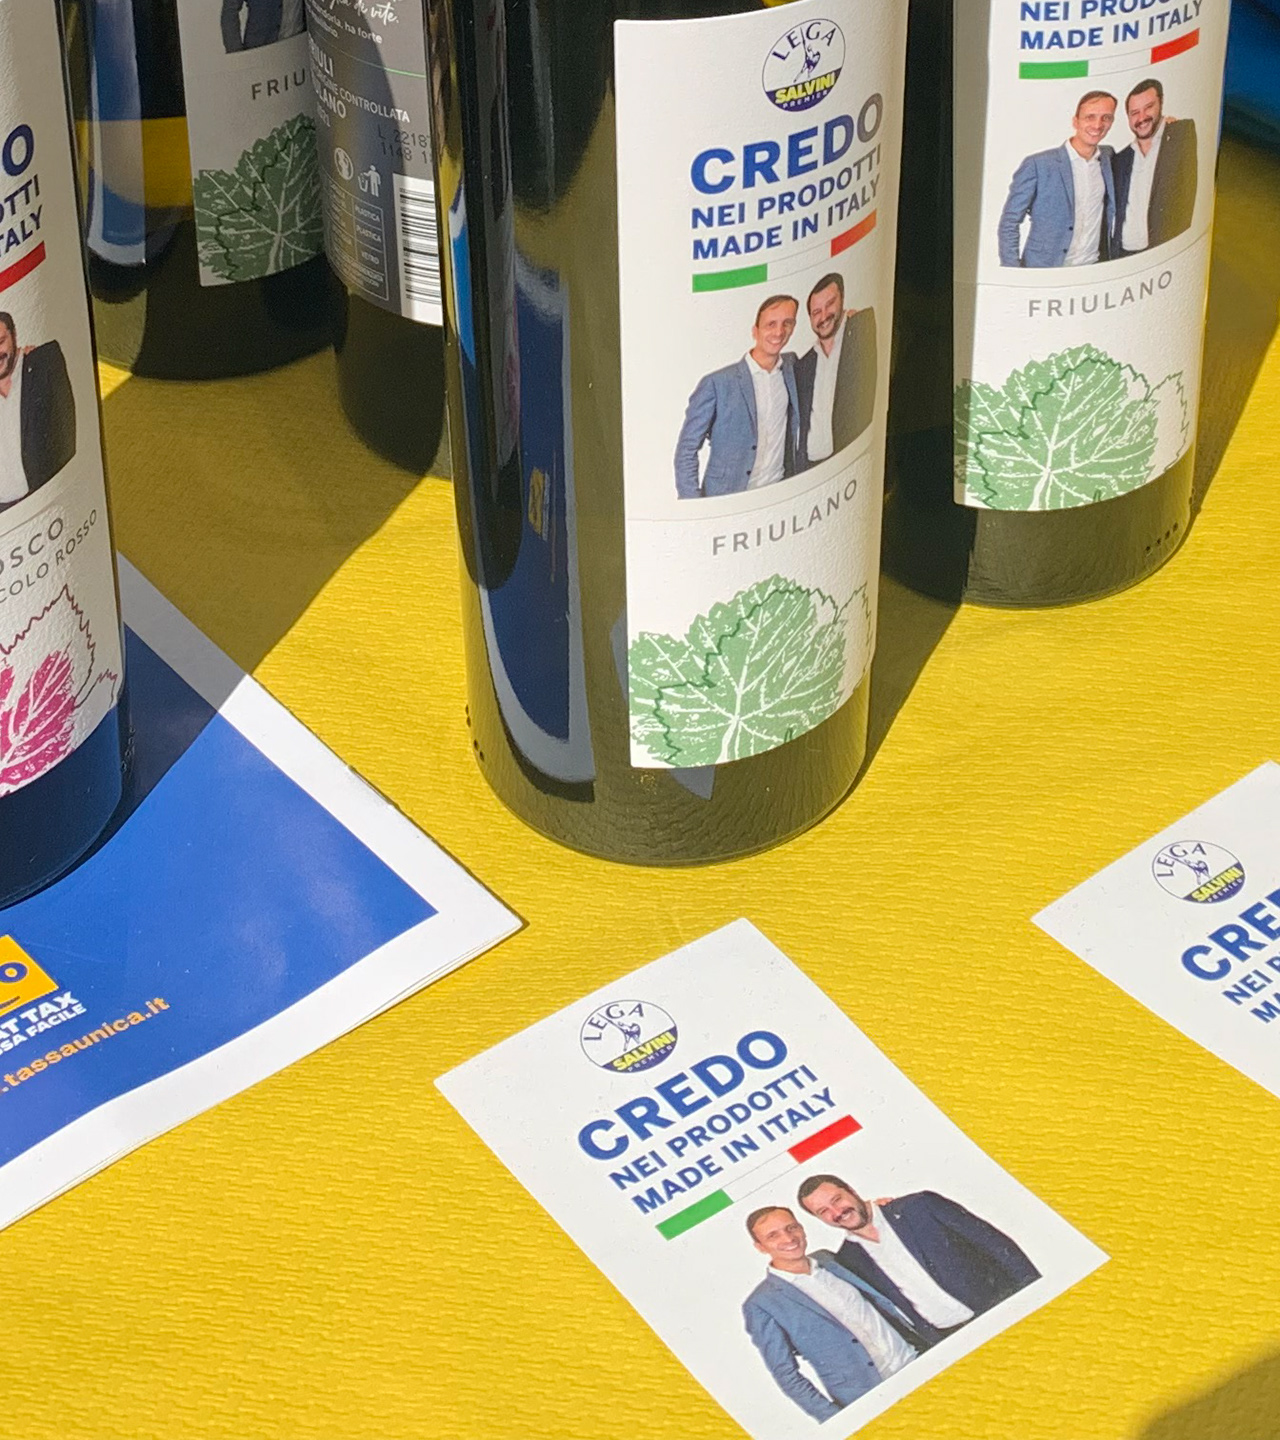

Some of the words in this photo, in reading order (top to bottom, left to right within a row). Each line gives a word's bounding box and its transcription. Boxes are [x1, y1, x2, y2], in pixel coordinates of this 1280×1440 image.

[370, 1, 400, 26] vite.
[1020, 0, 1070, 22] NEI
[357, 27, 383, 45] forte
[771, 21, 837, 63] LEGA
[1020, 27, 1104, 51] MADE
[1113, 20, 1140, 44] IN
[339, 86, 411, 124] CONTROLLATA
[775, 71, 836, 105] SALVINI
[690, 92, 884, 196] CREDO
[691, 201, 746, 229] NEI
[757, 143, 882, 220] PRODOTTI
[692, 225, 783, 260] MADE
[792, 212, 819, 242] IN
[827, 173, 881, 227] ITALY
[1028, 270, 1173, 318] FRIULANO
[54, 508, 98, 566] ROSSO
[712, 479, 858, 556] FRIULANO
[1157, 842, 1208, 879] LEGA
[1193, 865, 1245, 903] SALVINI
[1221, 968, 1274, 1005] NEI
[20, 991, 80, 1028] TAX
[27, 1004, 88, 1038] FACILE
[583, 1002, 645, 1042] LEGA
[612, 1030, 677, 1072] SALVINI
[577, 1030, 789, 1161] CREDO
[608, 1150, 668, 1190] NEI
[666, 1064, 819, 1158] PRODOTTI
[631, 1154, 723, 1215] MADE
[720, 1133, 760, 1163] IN
[757, 1087, 837, 1144] ITALY
